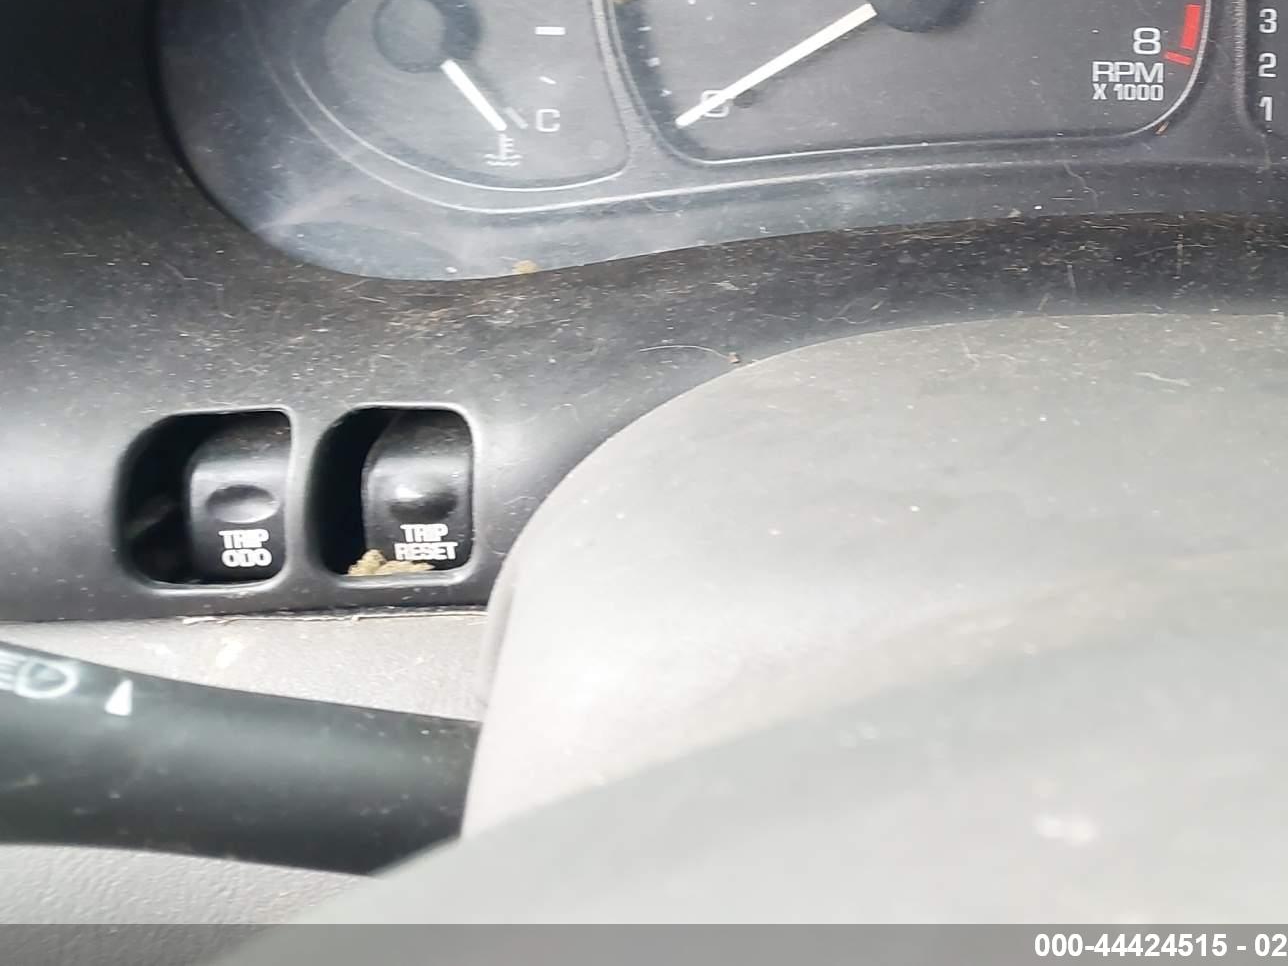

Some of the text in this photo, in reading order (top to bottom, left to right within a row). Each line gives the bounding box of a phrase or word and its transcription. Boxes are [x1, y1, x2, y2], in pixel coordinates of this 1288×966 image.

[1260, 9, 1277, 33] 3
[1133, 28, 1160, 54] 8
[1093, 62, 1163, 83] RPM
[1259, 53, 1276, 77] 2
[1093, 83, 1163, 100] X 1000
[1260, 97, 1272, 121] 1
[536, 109, 560, 132] C
[219, 529, 269, 548] TRIP
[400, 524, 448, 542] TRIP
[222, 548, 272, 567] ODO
[394, 542, 458, 560] RESET
